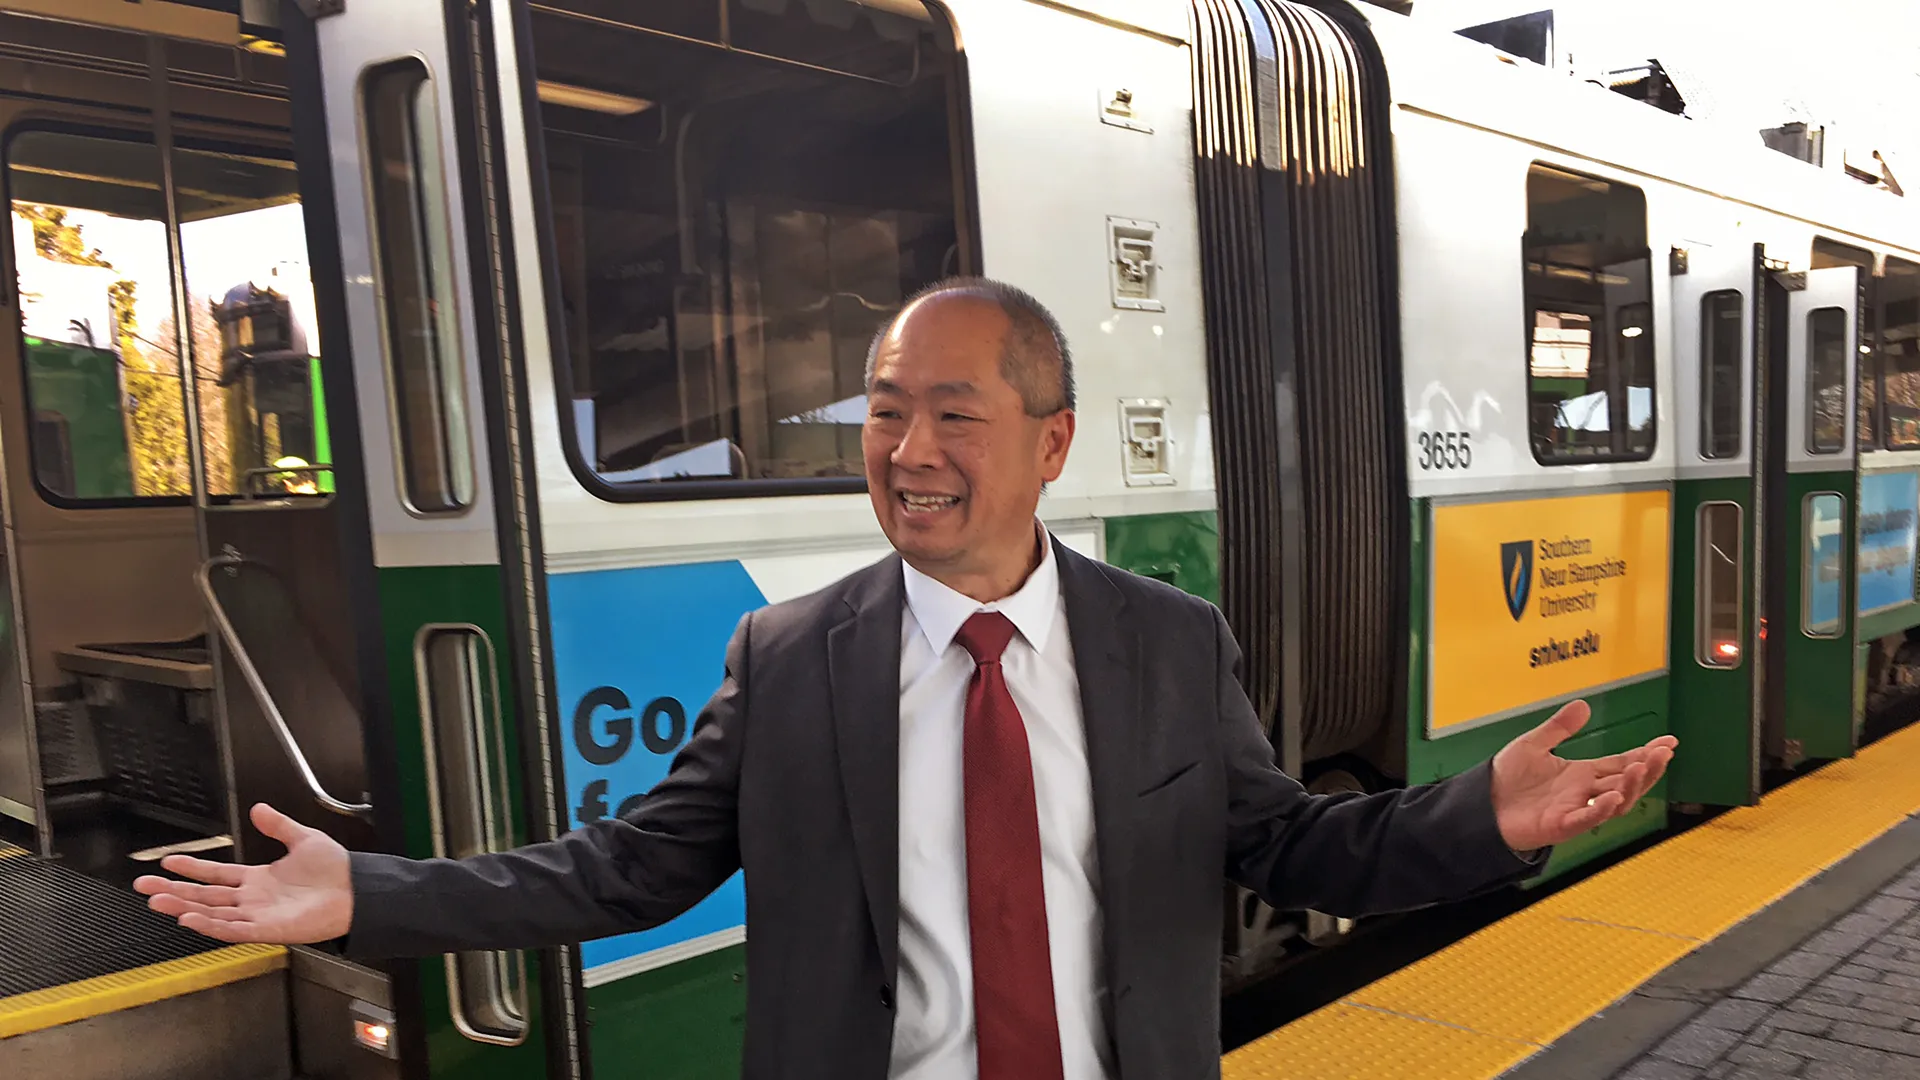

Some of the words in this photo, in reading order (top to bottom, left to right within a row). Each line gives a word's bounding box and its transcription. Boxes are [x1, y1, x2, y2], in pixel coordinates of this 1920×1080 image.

[1418, 431, 1472, 470] 3655
[1539, 535, 1592, 560] Southern
[1539, 567, 1567, 589] New
[1568, 557, 1626, 586] Hampshire
[1539, 589, 1598, 618] University
[1529, 629, 1600, 668] snhu.edu
